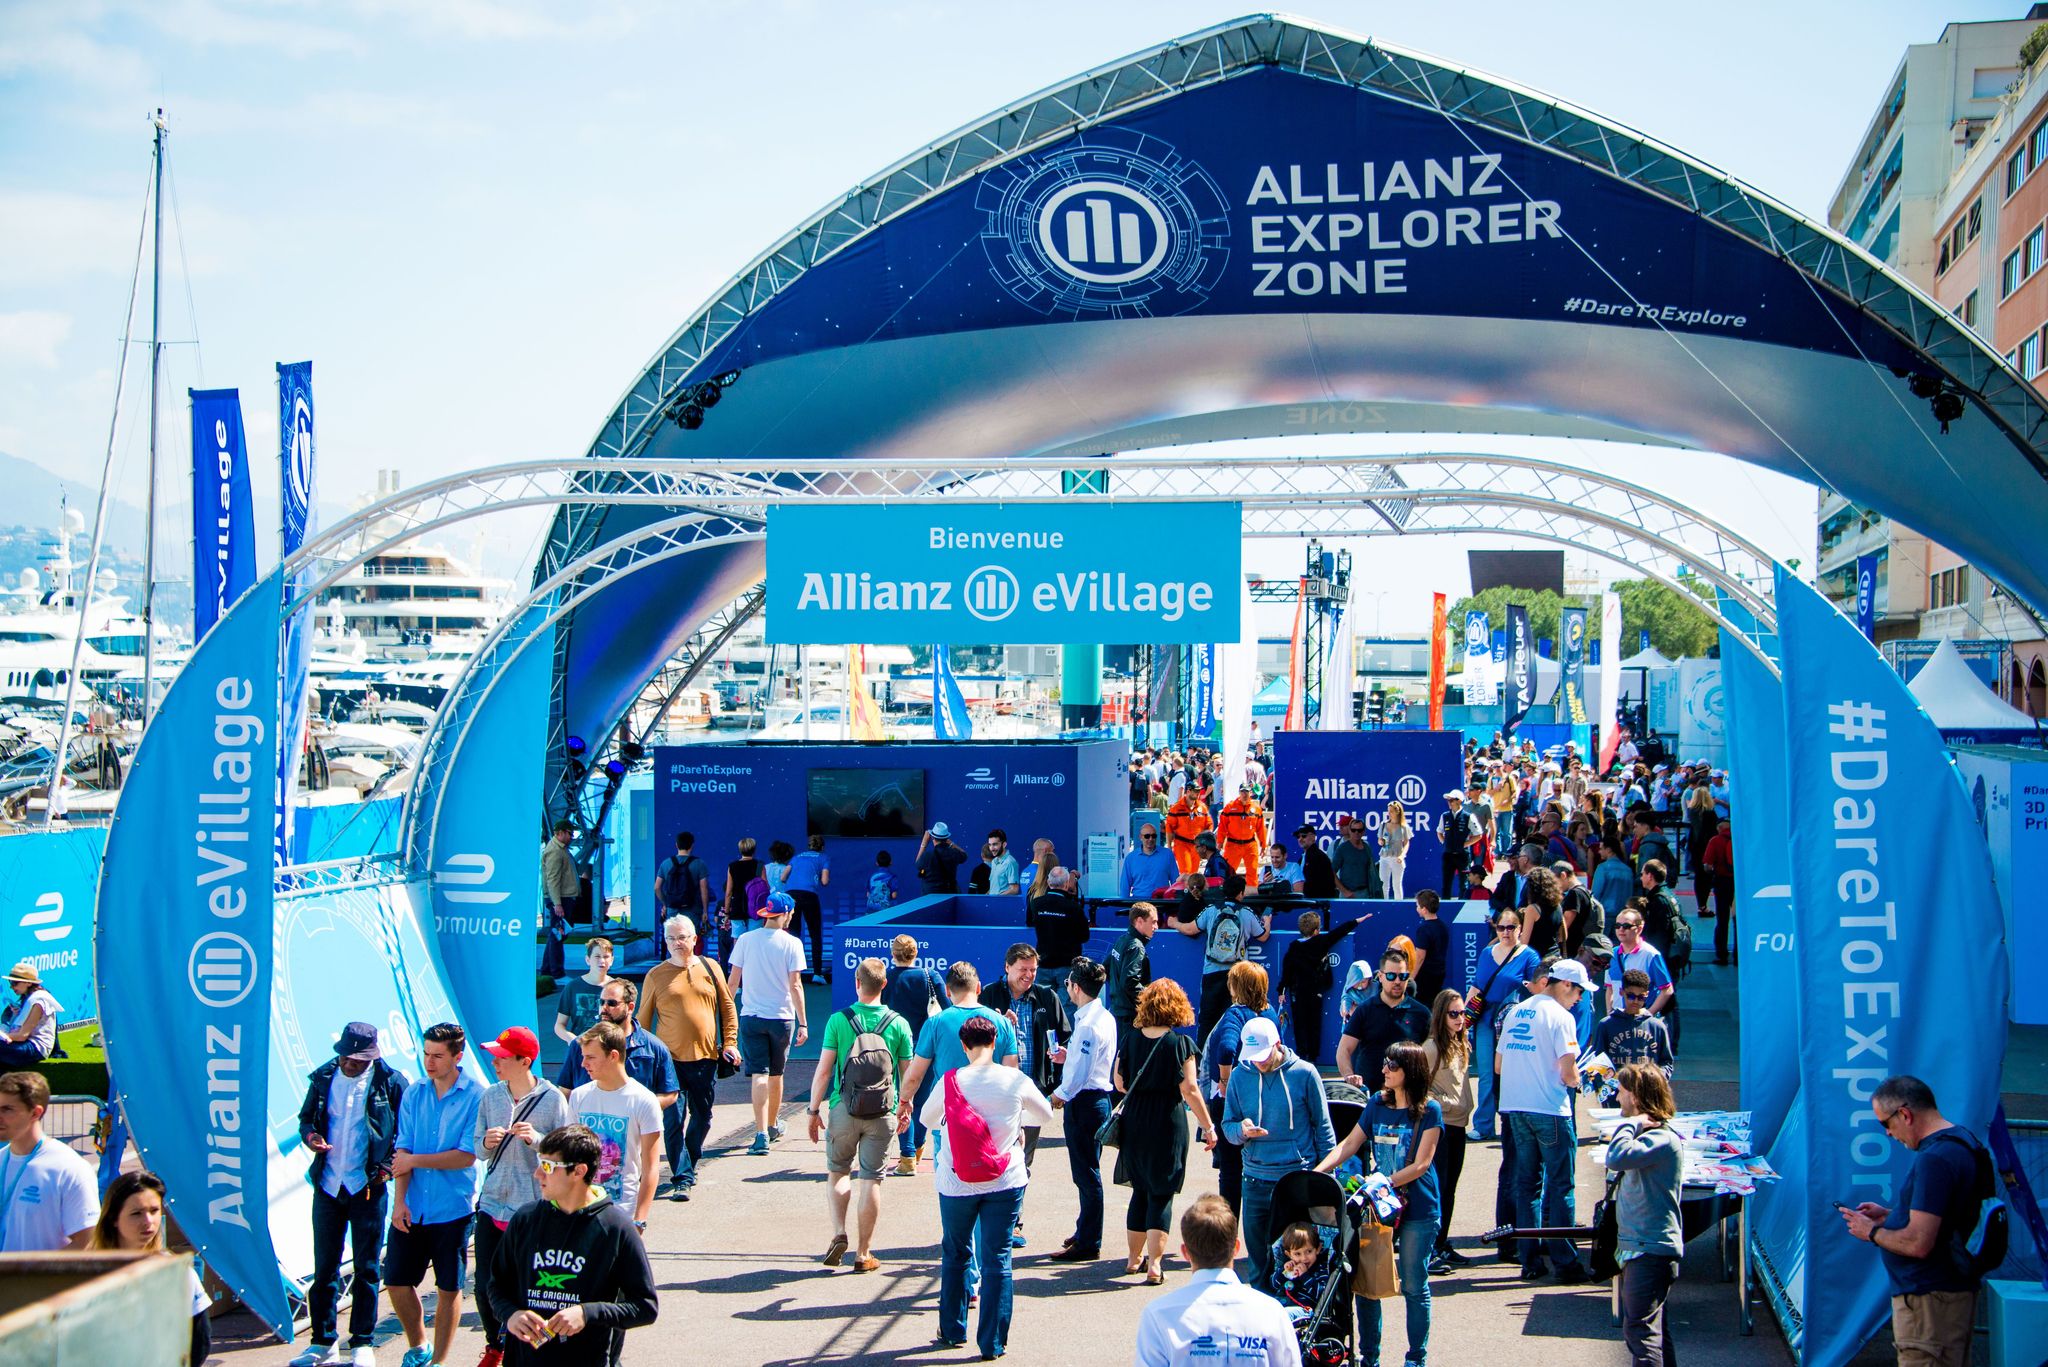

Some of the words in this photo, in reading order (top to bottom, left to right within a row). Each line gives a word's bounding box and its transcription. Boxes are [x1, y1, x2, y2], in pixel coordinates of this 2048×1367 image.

[1246, 153, 1503, 206] ALLIANZ
[1251, 200, 1564, 254] EXPLORER
[1252, 259, 1408, 297] ZONE
[1563, 296, 1748, 328] #DareToExplore
[929, 527, 1064, 549] Bienvenue
[796, 572, 952, 611] Allianz
[1032, 571, 1213, 622] eVillage
[671, 764, 752, 776] #DareToExplore
[1013, 774, 1050, 785] Allianz
[671, 779, 737, 793] PaveGen
[1305, 778, 1389, 800] Allianz
[195, 676, 265, 919] eVillage
[2024, 801, 2045, 814] 3D
[1827, 699, 1901, 1202] #DareToExplor
[1515, 1008, 1537, 1019] INFO
[205, 1024, 253, 1234] Allianz
[533, 1249, 586, 1273] ASICS
[527, 1289, 541, 1298] THE
[543, 1291, 581, 1302] ORIGINAL
[527, 1299, 557, 1309] TRAINING
[1238, 1336, 1268, 1350] VISA
